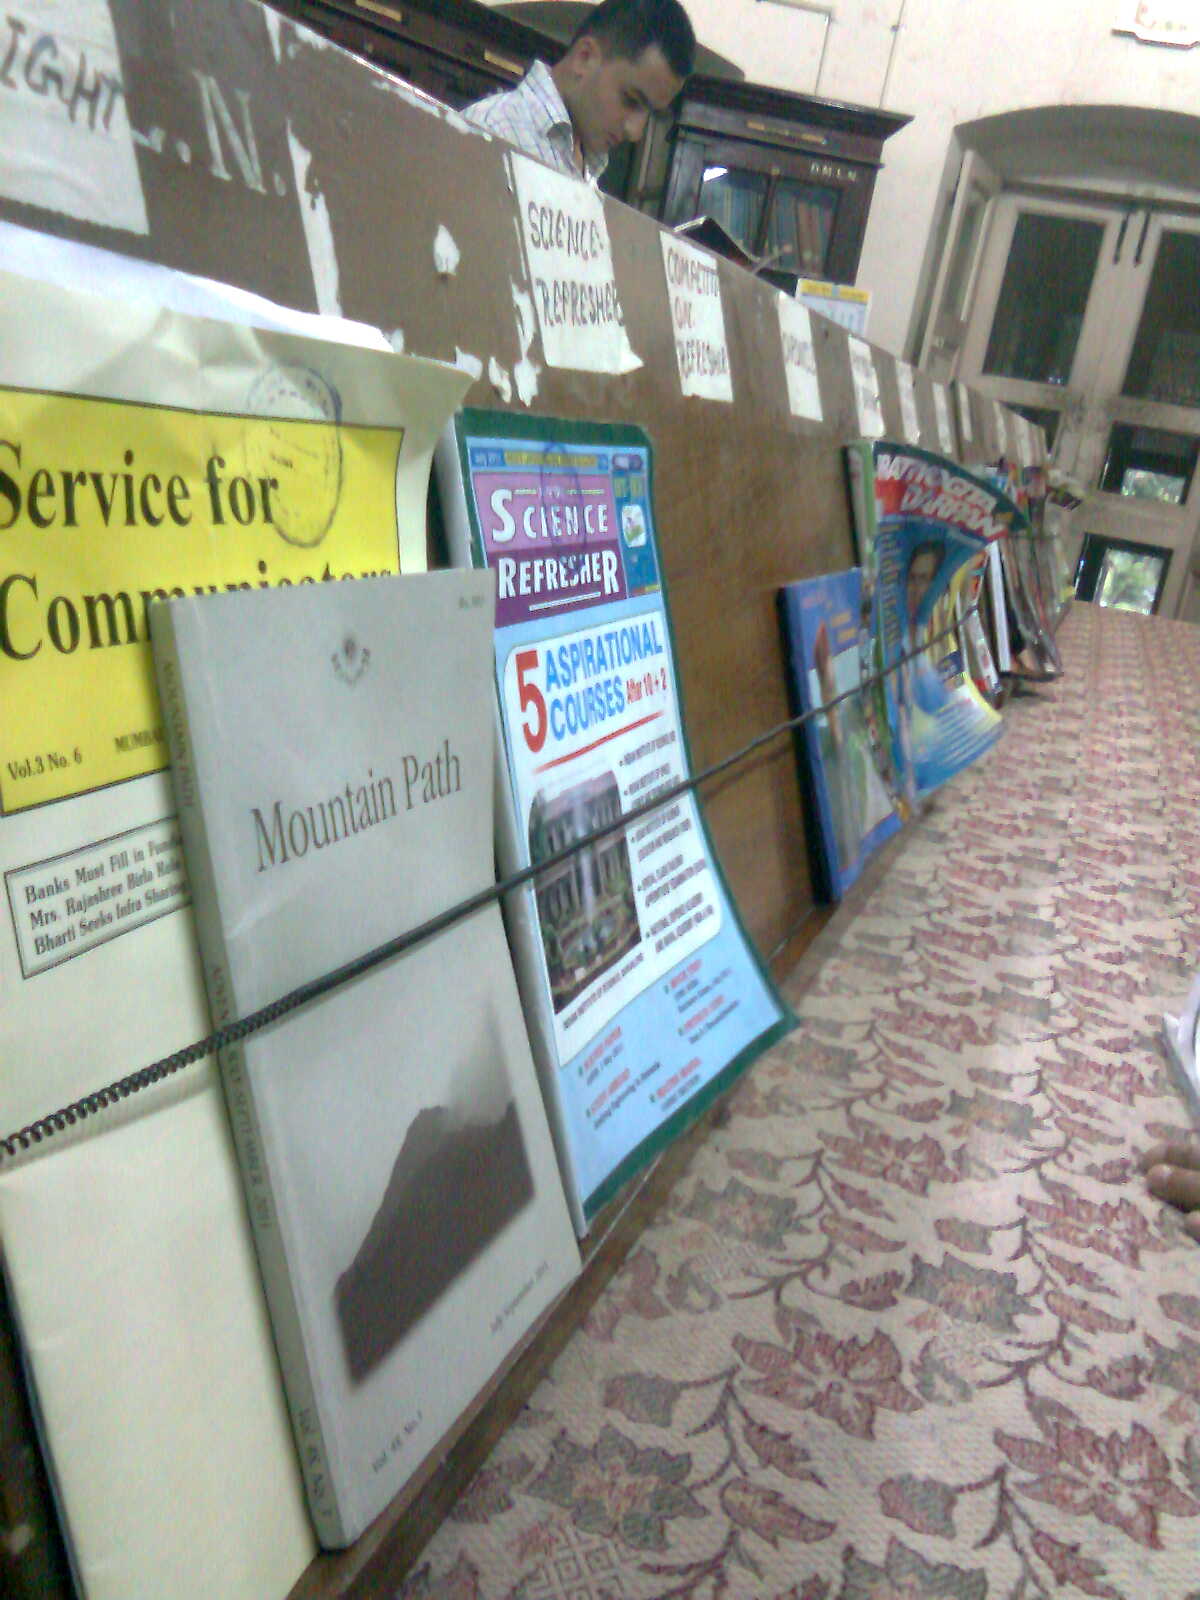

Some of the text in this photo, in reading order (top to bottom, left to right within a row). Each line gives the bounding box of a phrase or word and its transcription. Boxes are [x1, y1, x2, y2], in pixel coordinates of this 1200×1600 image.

[527, 200, 604, 261] SCIENCE
[0, 439, 192, 530] Service
[206, 453, 280, 526] for
[489, 487, 609, 544] SCIENCE
[498, 549, 621, 600] REFRESHER
[515, 648, 548, 754] 5
[545, 620, 663, 692] ASPIRATIONAL
[550, 675, 626, 741] COURSES
[251, 739, 462, 873] Mountain Path
[25, 876, 71, 904] Banks
[75, 862, 105, 885] Must
[109, 850, 130, 873] Fill
[34, 925, 77, 956] Bharti
